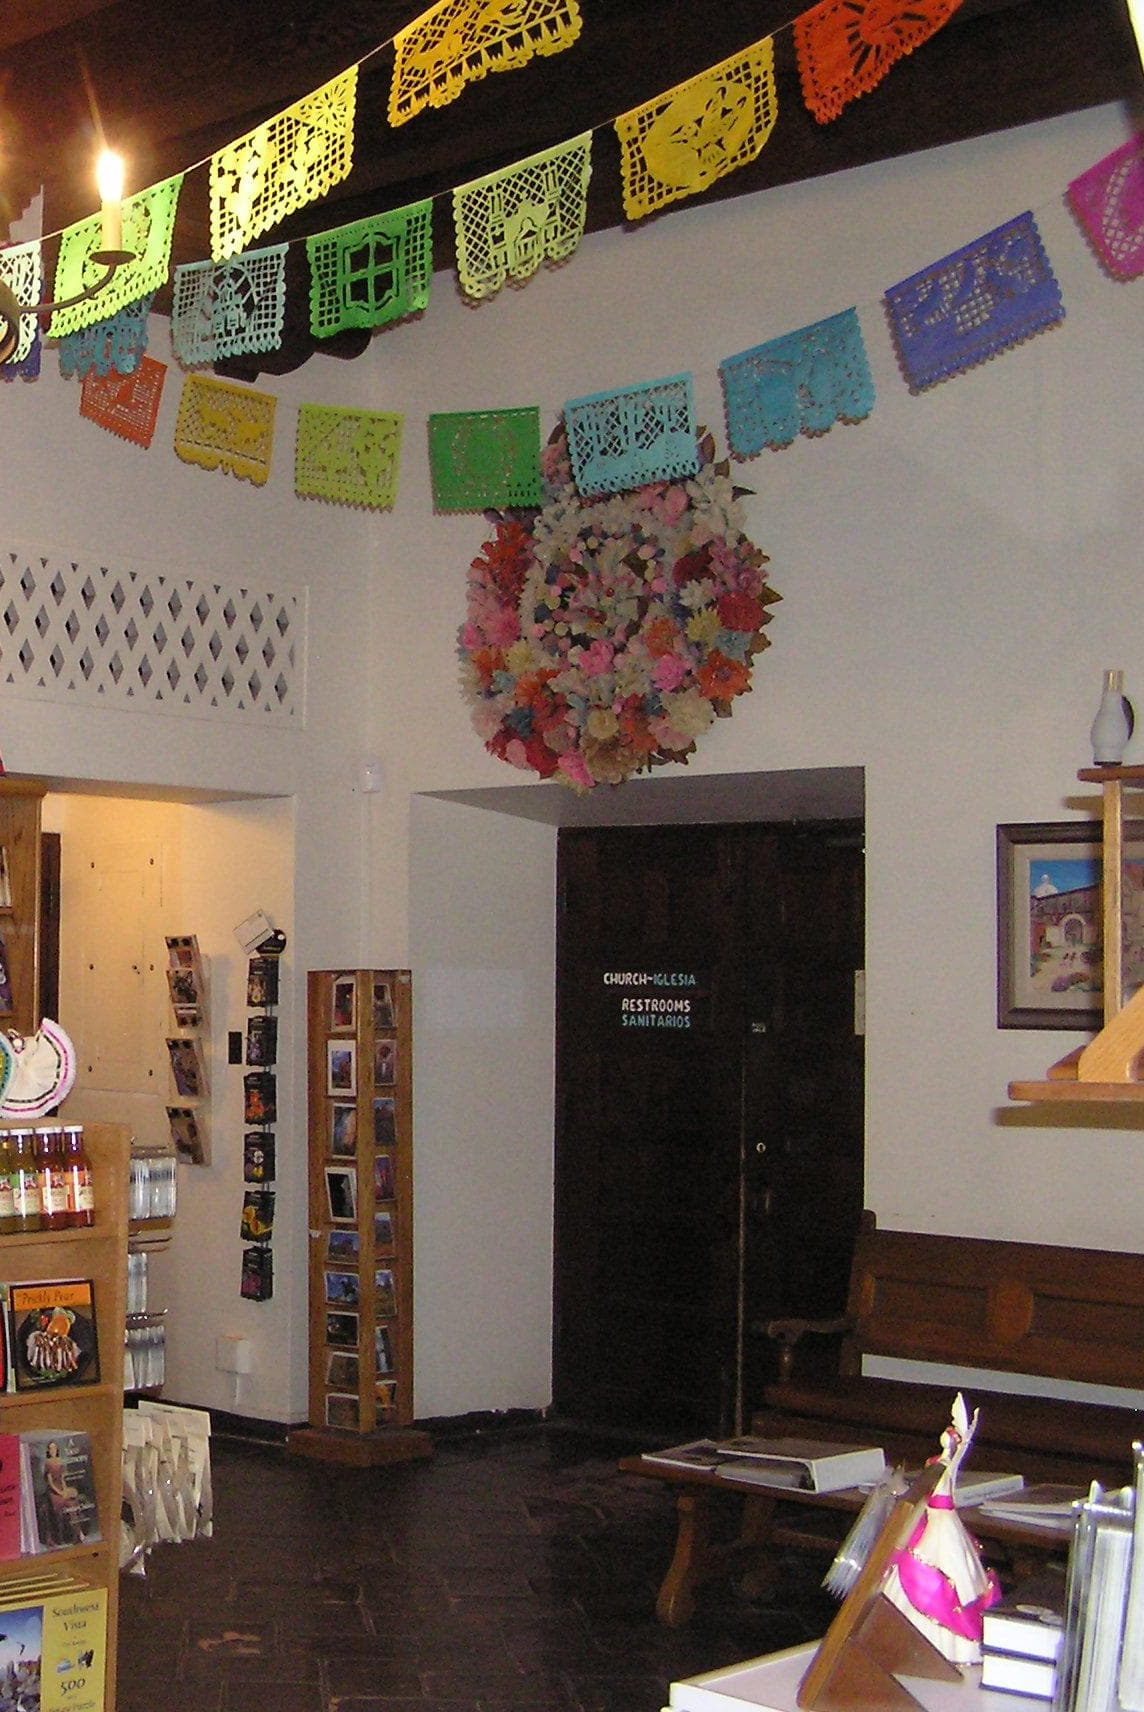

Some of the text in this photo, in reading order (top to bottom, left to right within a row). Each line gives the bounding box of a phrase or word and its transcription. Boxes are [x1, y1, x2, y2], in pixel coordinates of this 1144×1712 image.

[621, 998, 691, 1013] RESTROOMS
[621, 1014, 691, 1028] SANITARIOS
[55, 1291, 74, 1301] Pear
[52, 1602, 100, 1618] Southwest
[63, 1620, 87, 1632] Vista
[60, 1677, 86, 1697] 500
